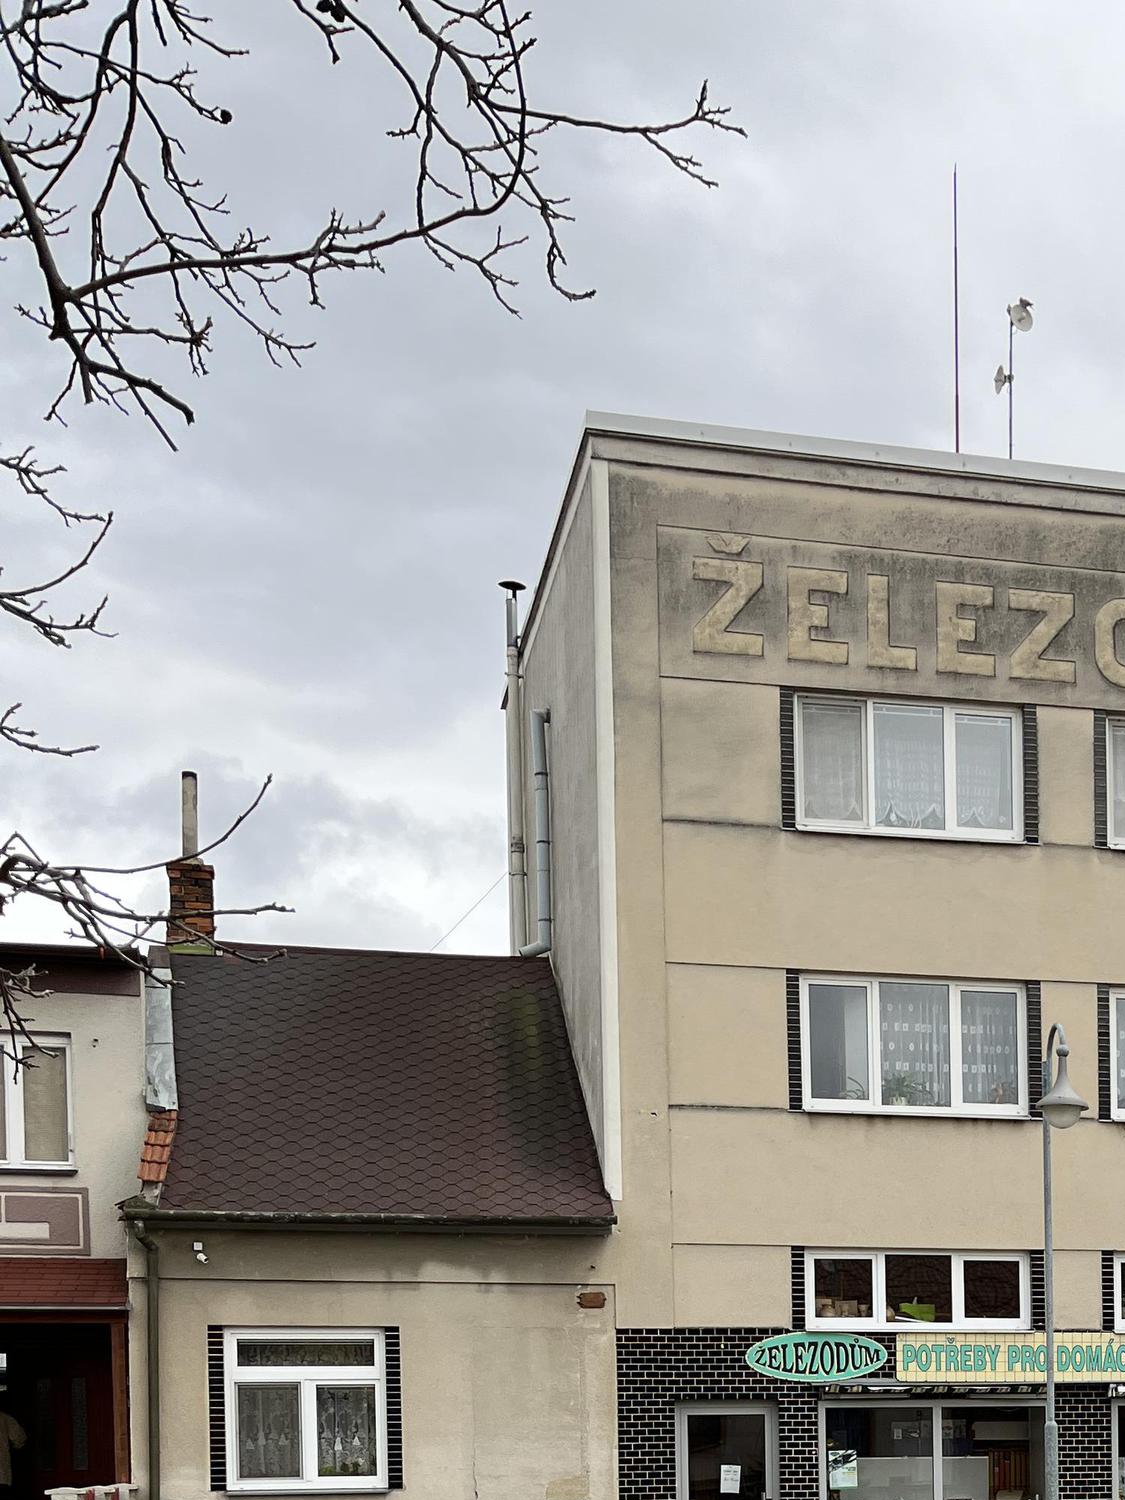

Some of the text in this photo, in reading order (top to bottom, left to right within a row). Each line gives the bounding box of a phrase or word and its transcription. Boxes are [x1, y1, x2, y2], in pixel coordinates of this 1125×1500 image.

[753, 1338, 882, 1376] ŽELEZODŮM
[902, 1337, 1000, 1372] POTŘEBY
[1007, 1343, 1048, 1372] PRO
